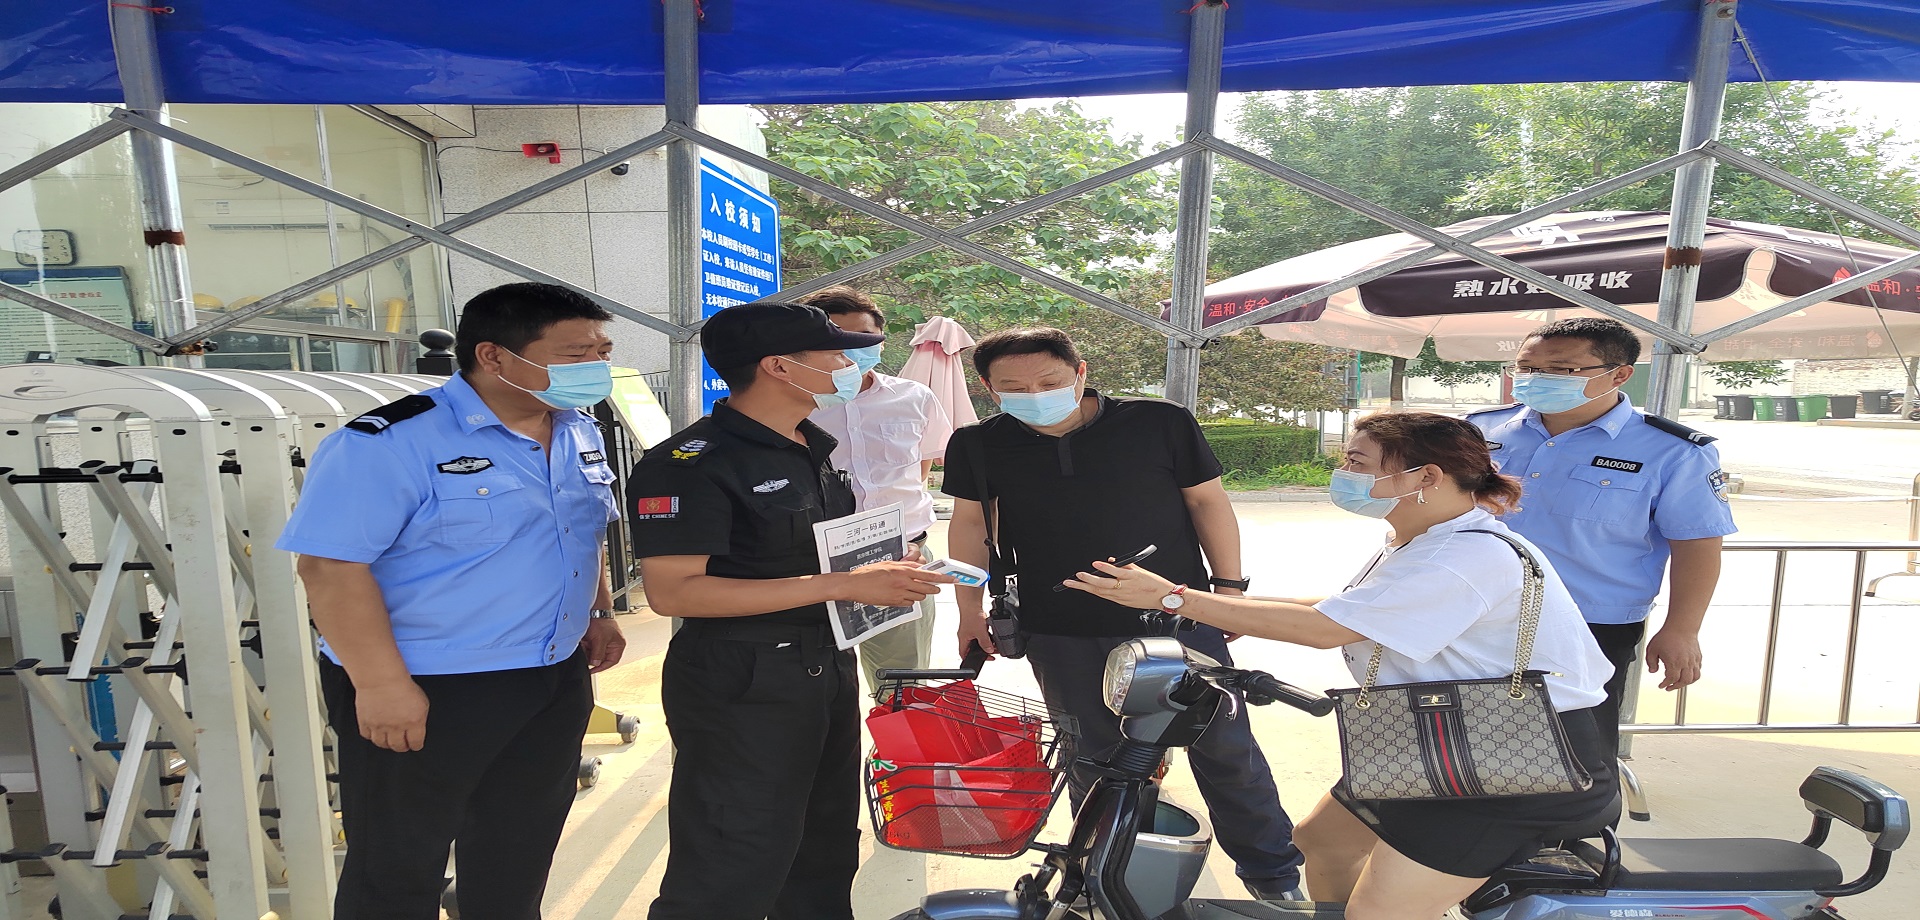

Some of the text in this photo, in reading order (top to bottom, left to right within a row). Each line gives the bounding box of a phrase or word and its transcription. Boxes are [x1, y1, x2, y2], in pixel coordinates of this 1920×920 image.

[709, 192, 761, 234] 入校须知
[1596, 458, 1637, 471] BA0008
[846, 520, 887, 539] 三河一码通
